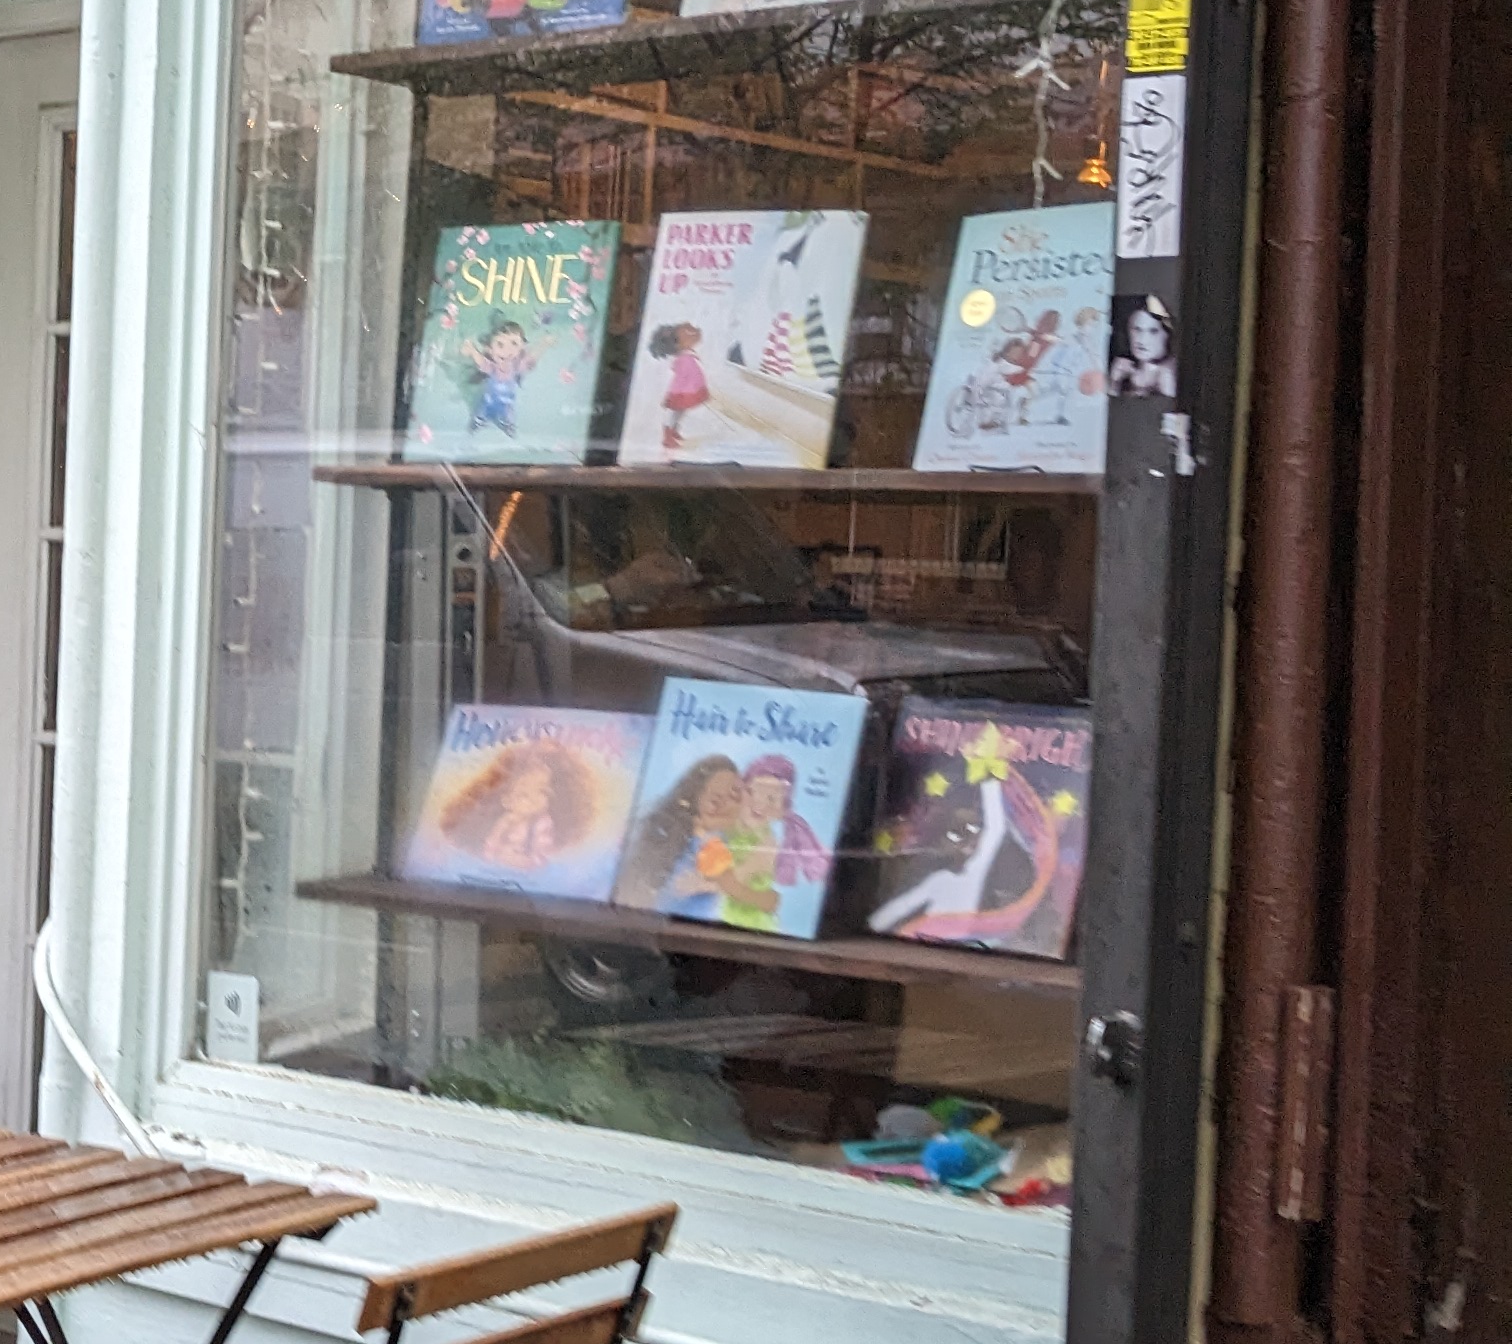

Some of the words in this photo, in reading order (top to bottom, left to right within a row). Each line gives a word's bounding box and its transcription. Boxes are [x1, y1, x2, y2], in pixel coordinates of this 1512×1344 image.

[667, 223, 754, 246] PARKER
[663, 248, 735, 270] LOOKS
[456, 254, 580, 307] SHINE
[659, 273, 690, 295] UP
[758, 700, 839, 749] Share
